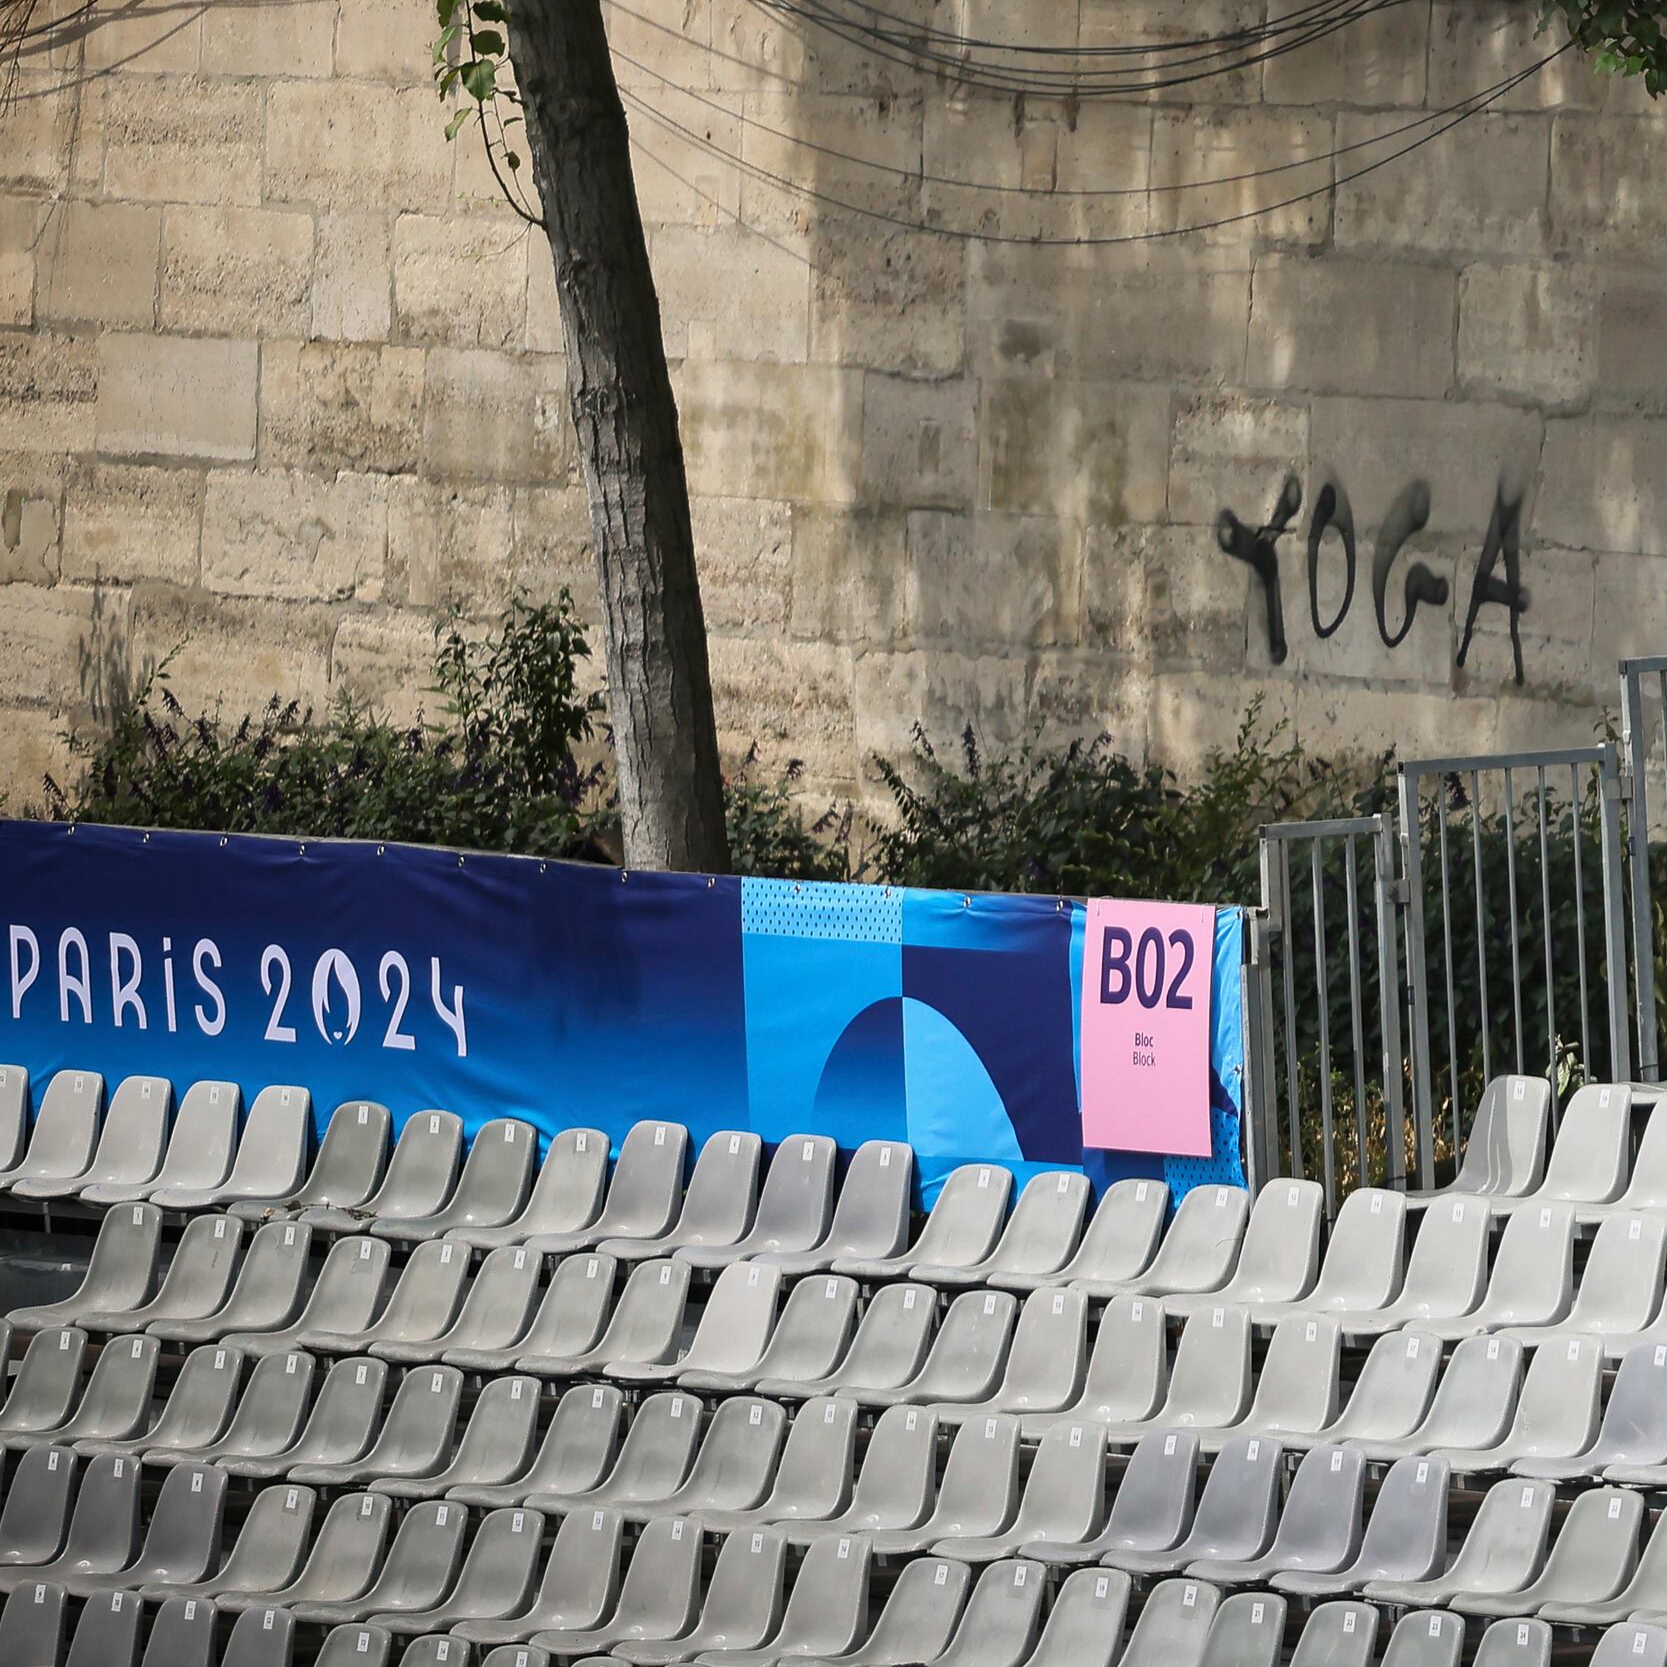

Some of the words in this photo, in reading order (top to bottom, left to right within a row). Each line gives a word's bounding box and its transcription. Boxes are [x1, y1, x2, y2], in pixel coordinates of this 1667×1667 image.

[1217, 467, 1530, 685] YOGA
[261, 945, 466, 1056] 2024
[1100, 926, 1194, 1010] B02
[1132, 1052, 1156, 1067] Block
[1134, 1032, 1154, 1047] Bloc
